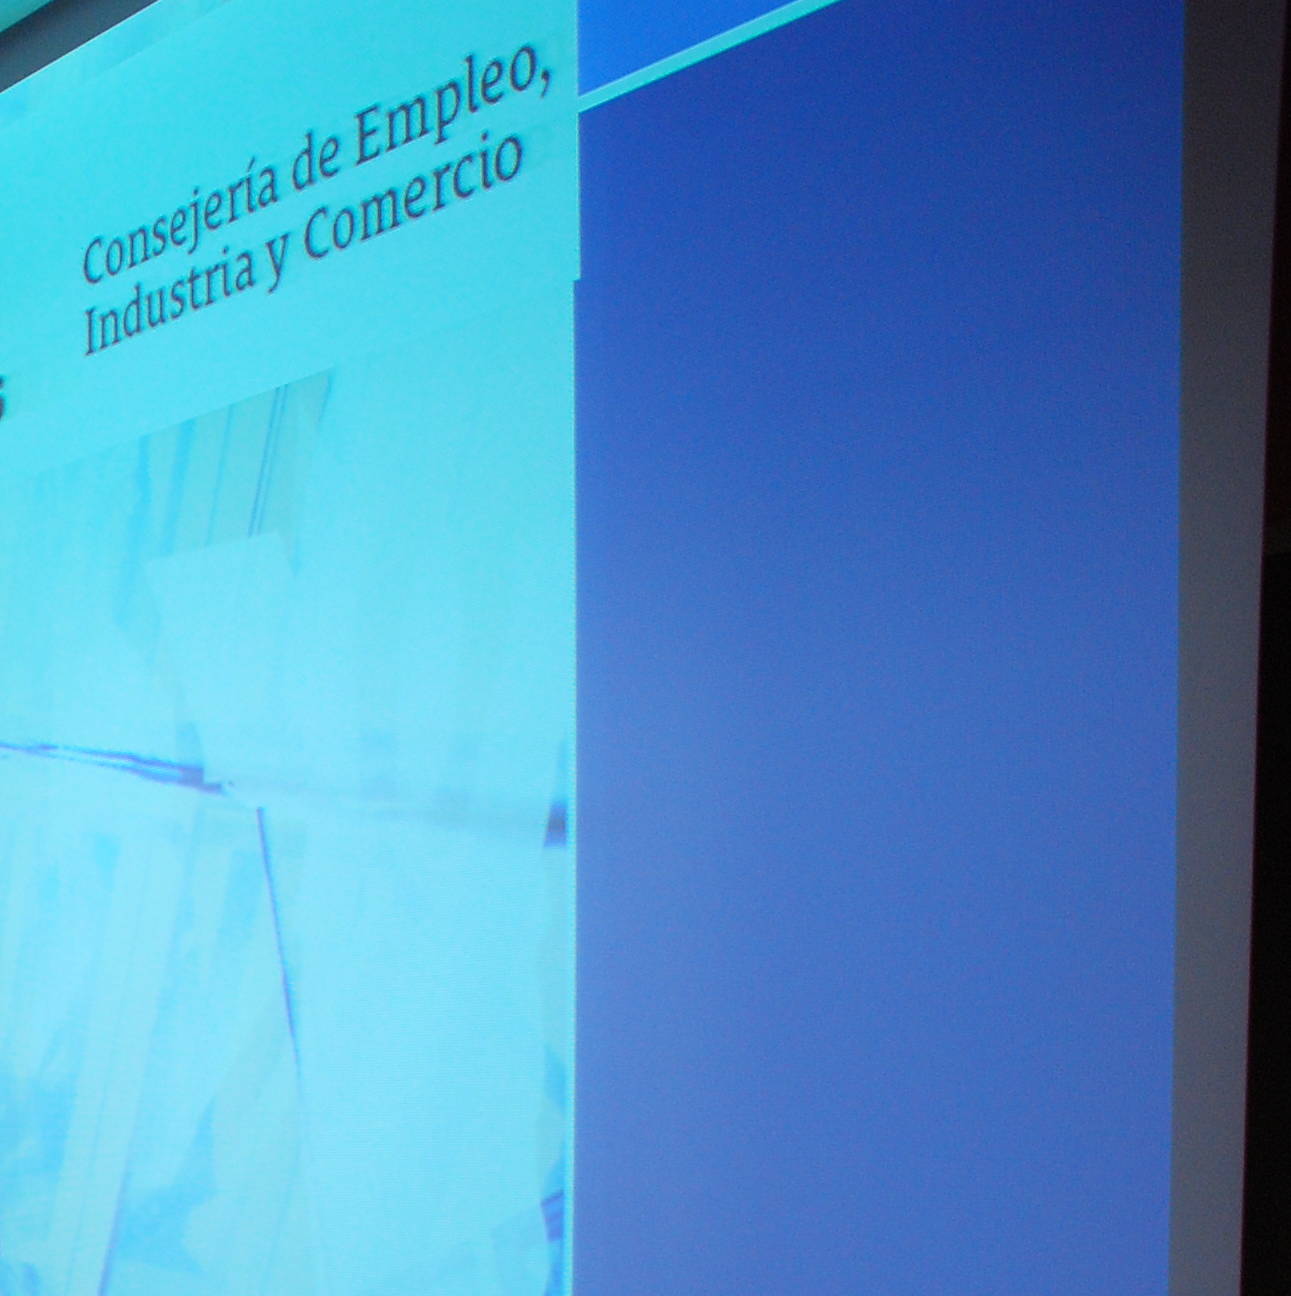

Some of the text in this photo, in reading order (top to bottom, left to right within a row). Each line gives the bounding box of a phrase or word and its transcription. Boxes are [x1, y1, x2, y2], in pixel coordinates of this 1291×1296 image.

[82, 40, 553, 286] Consejería de Empleo,
[84, 131, 525, 357] Industria y Comercio
